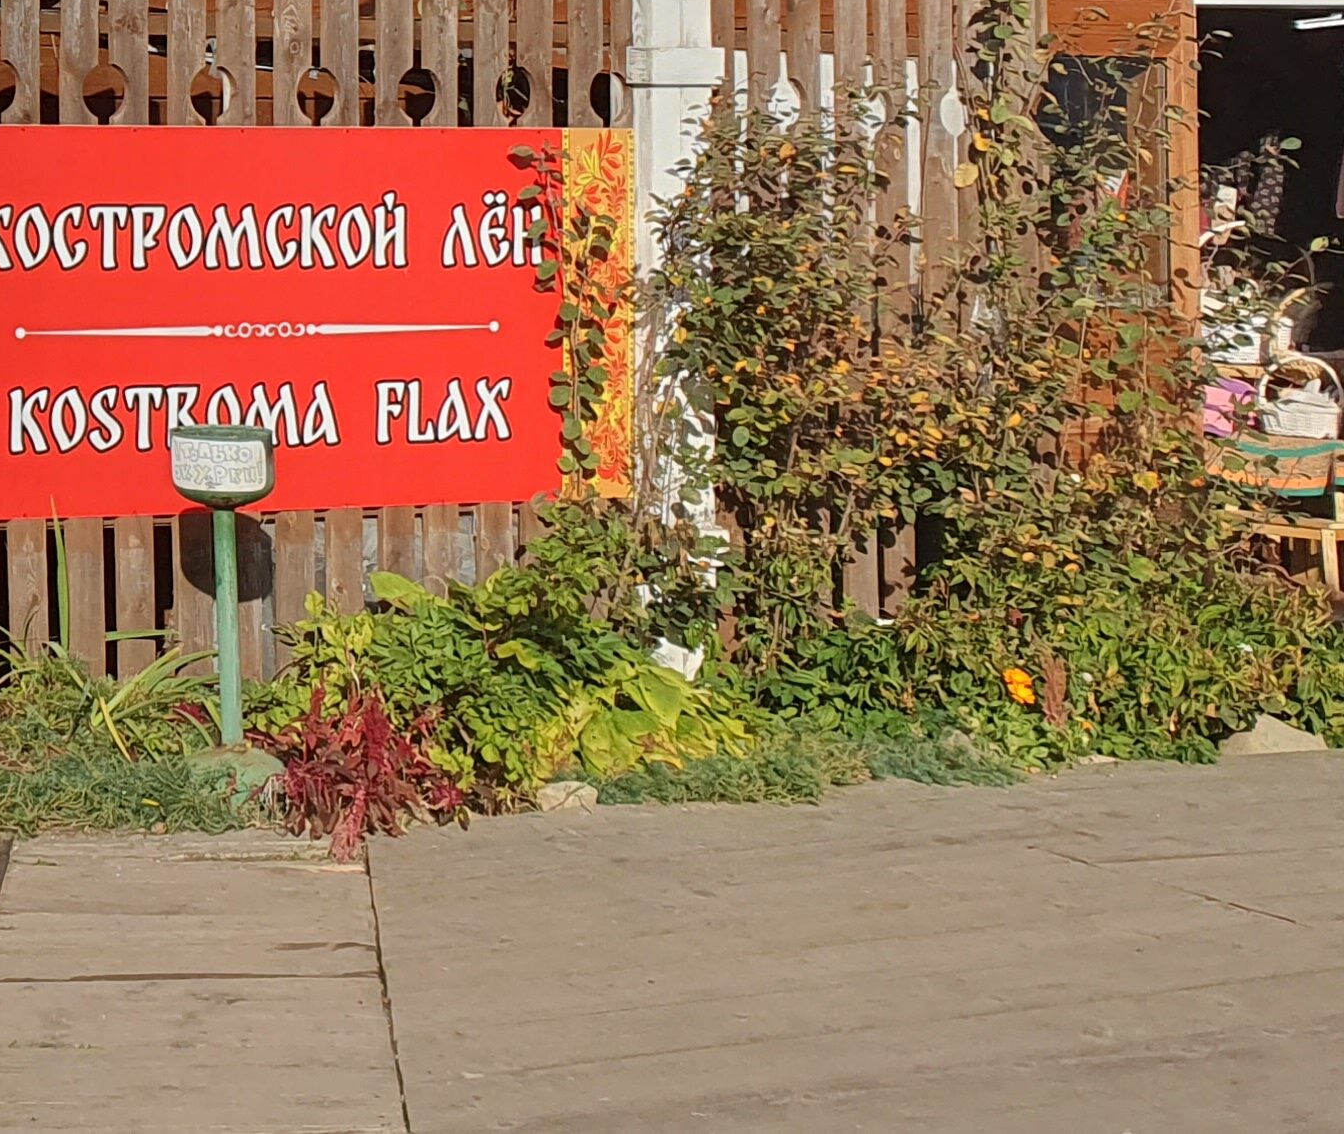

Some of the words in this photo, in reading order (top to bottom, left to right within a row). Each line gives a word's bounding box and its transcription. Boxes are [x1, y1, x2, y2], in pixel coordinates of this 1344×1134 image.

[442, 190, 544, 268] ЛЁН
[8, 382, 339, 454] KOSTROMA
[376, 377, 512, 445] FLAX
